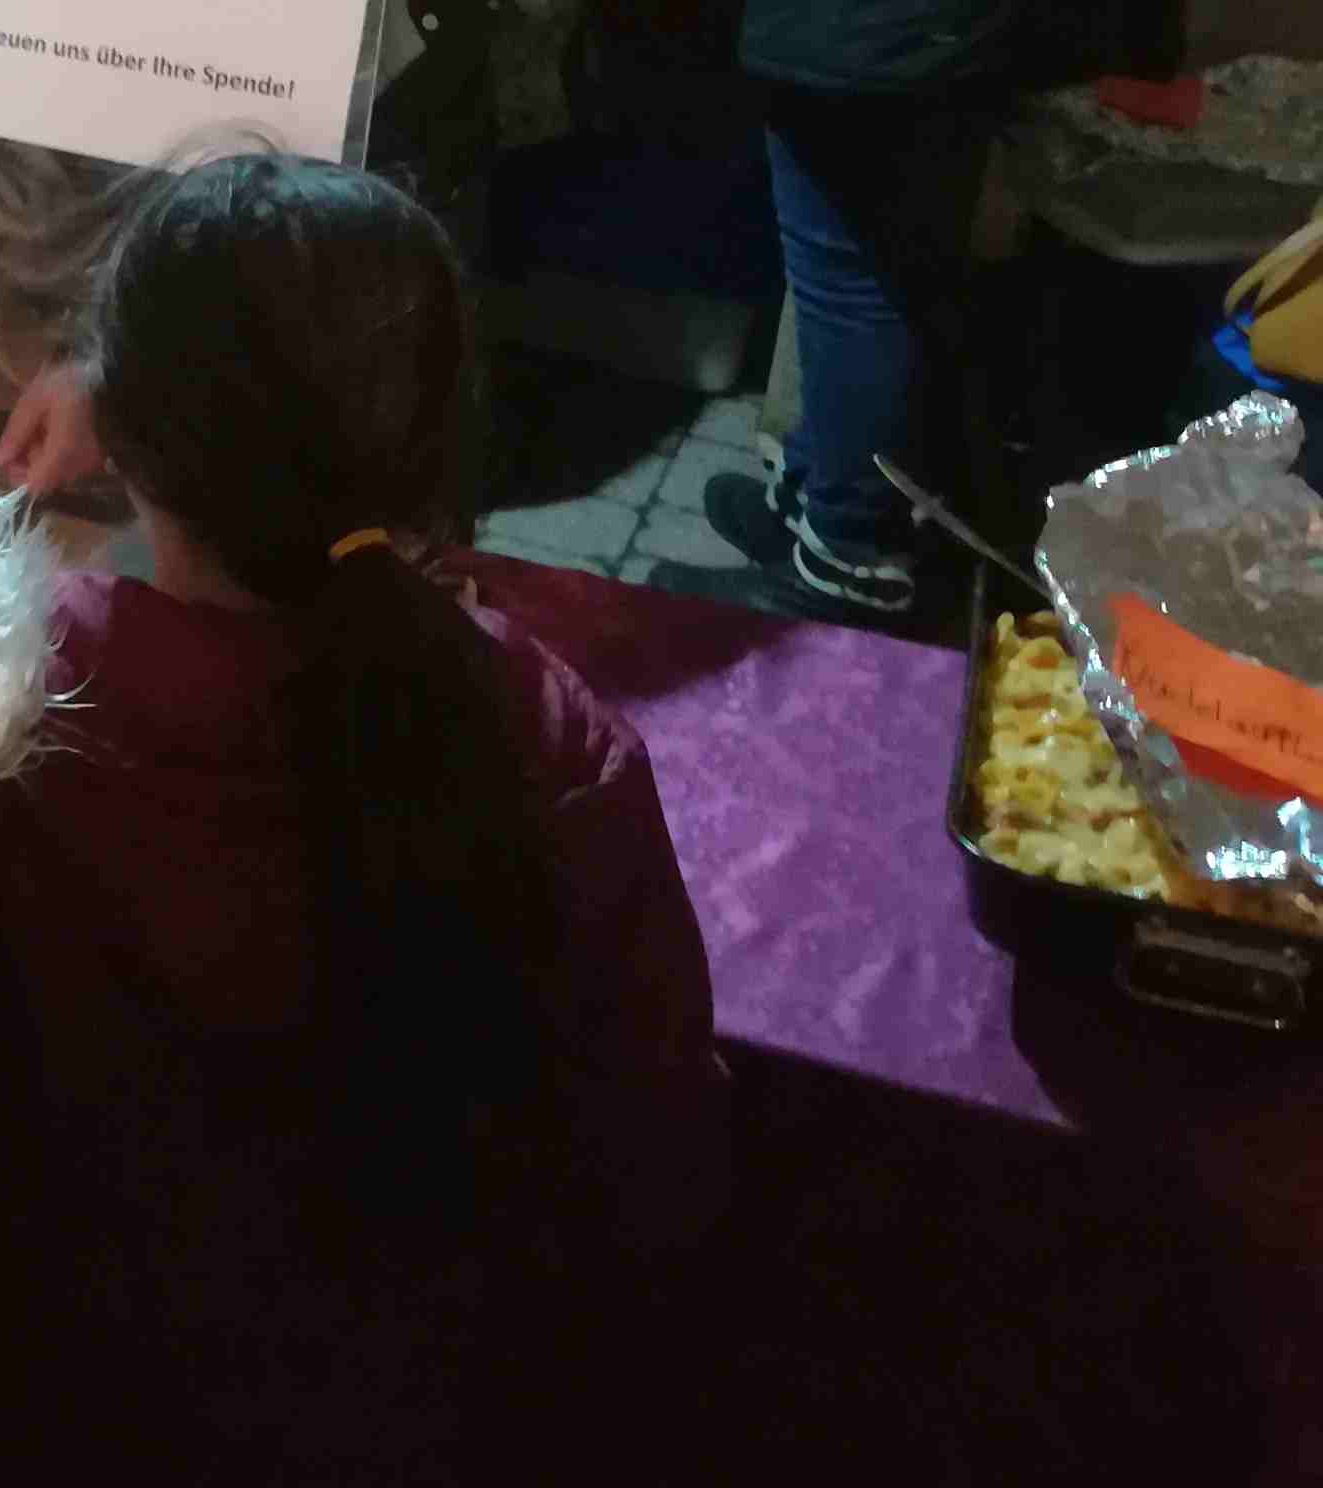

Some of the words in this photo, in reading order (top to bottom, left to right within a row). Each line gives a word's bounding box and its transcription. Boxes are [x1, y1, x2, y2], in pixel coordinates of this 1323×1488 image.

[53, 40, 90, 62] uns
[97, 45, 146, 73] über
[153, 56, 196, 82] Ihre
[203, 64, 297, 101] Spende!
